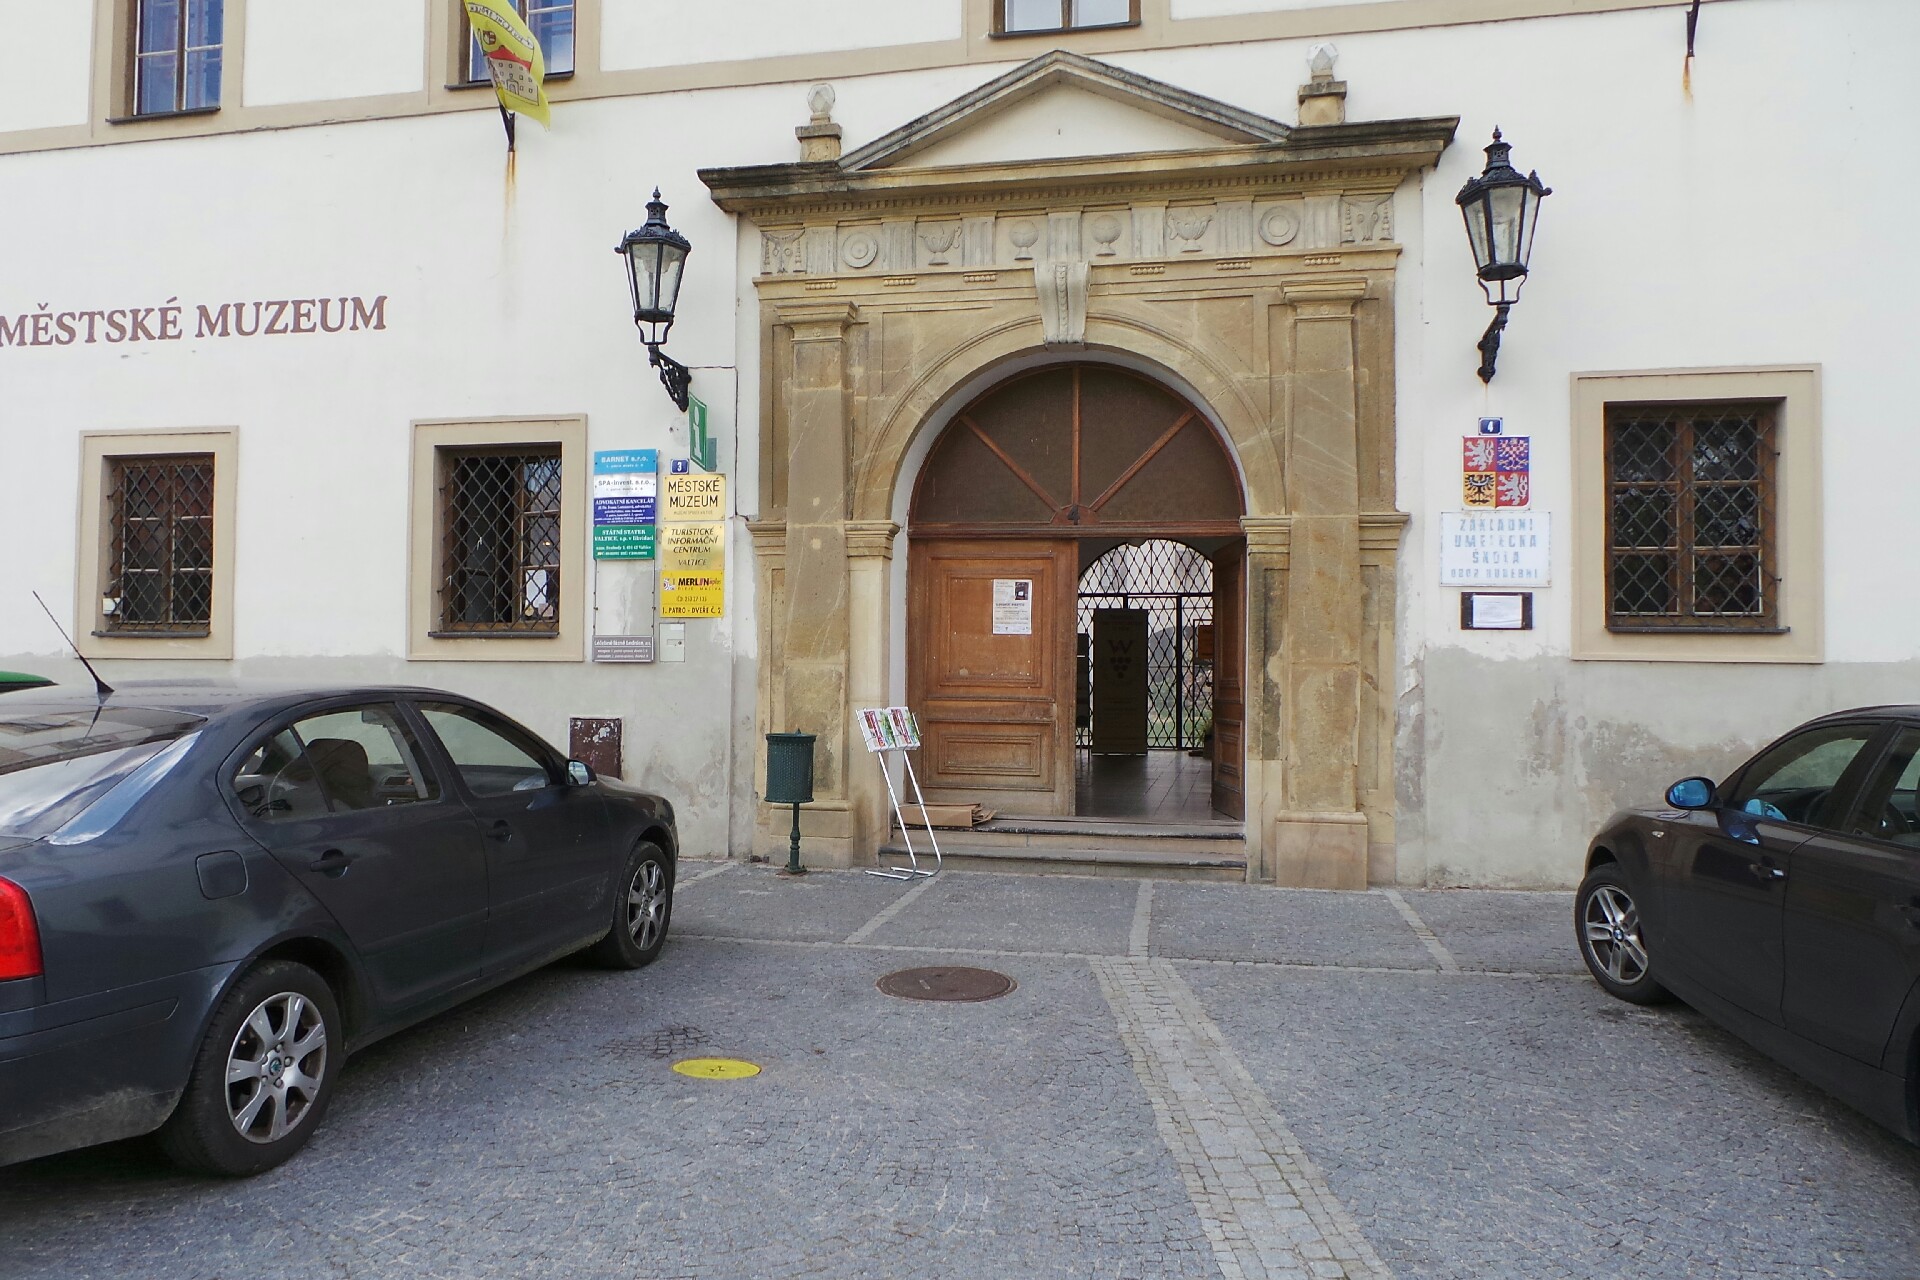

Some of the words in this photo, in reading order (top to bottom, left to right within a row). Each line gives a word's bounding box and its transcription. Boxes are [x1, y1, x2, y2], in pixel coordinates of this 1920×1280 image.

[0, 296, 182, 347] MĚSTSKÉ
[195, 295, 388, 338] MUZEUM
[677, 461, 682, 472] 3
[668, 477, 720, 493] MĚSTSKÉ
[669, 494, 718, 508] MUZEUM
[671, 526, 714, 536] TURISTICKÉ
[667, 535, 719, 545] INFORMAČNÍ
[673, 546, 711, 554] CENTRUM
[678, 558, 708, 566] VALTICE
[668, 606, 686, 614] PATRO
